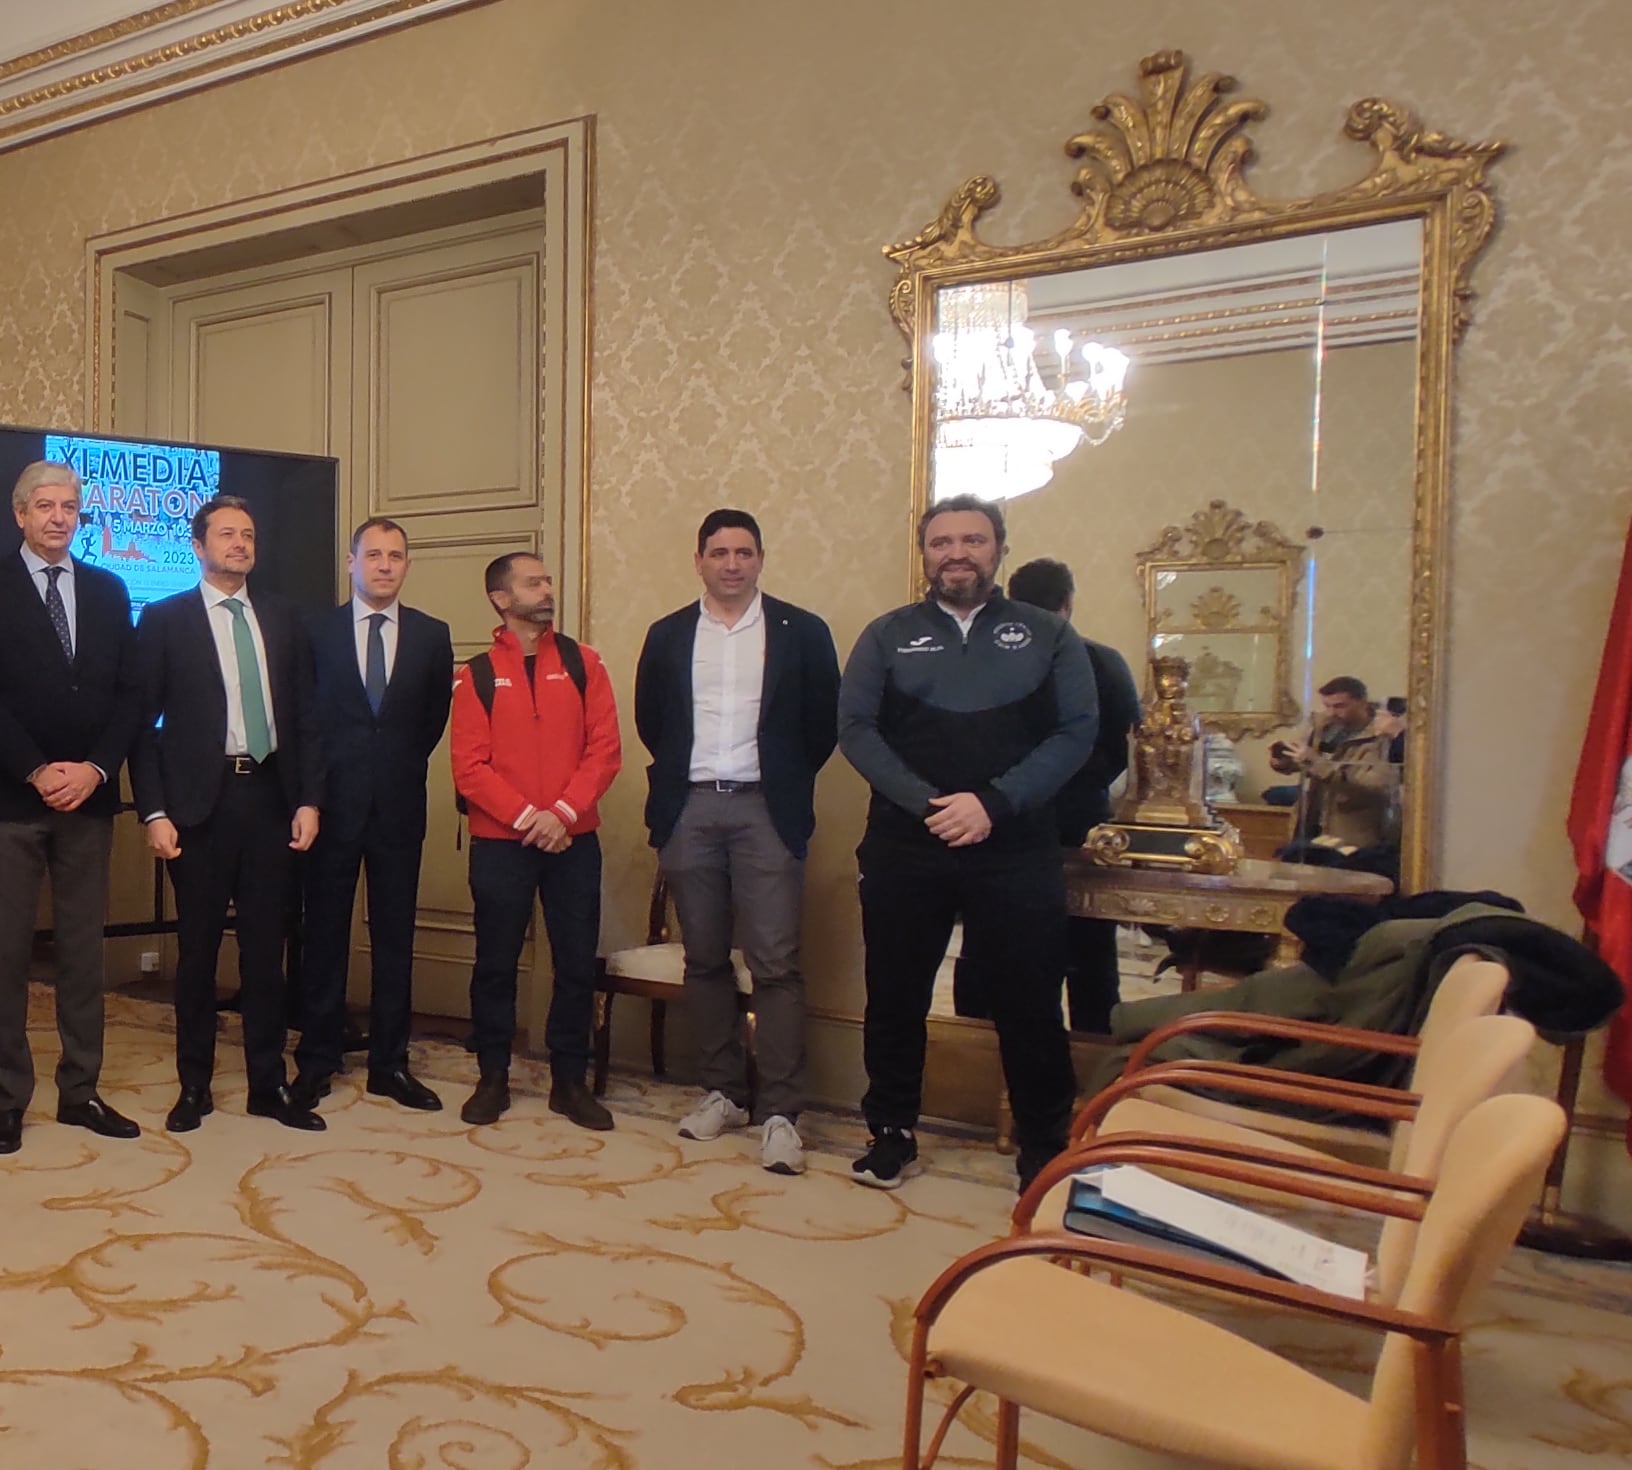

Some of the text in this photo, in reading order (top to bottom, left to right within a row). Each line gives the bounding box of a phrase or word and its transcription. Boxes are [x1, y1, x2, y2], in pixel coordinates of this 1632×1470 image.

[58, 446, 209, 487] XI MEDIA
[113, 519, 193, 538] 5 MARZO 10:3
[163, 550, 194, 565] 2023
[134, 563, 145, 572] DE
[146, 564, 197, 575] SALAMANCA
